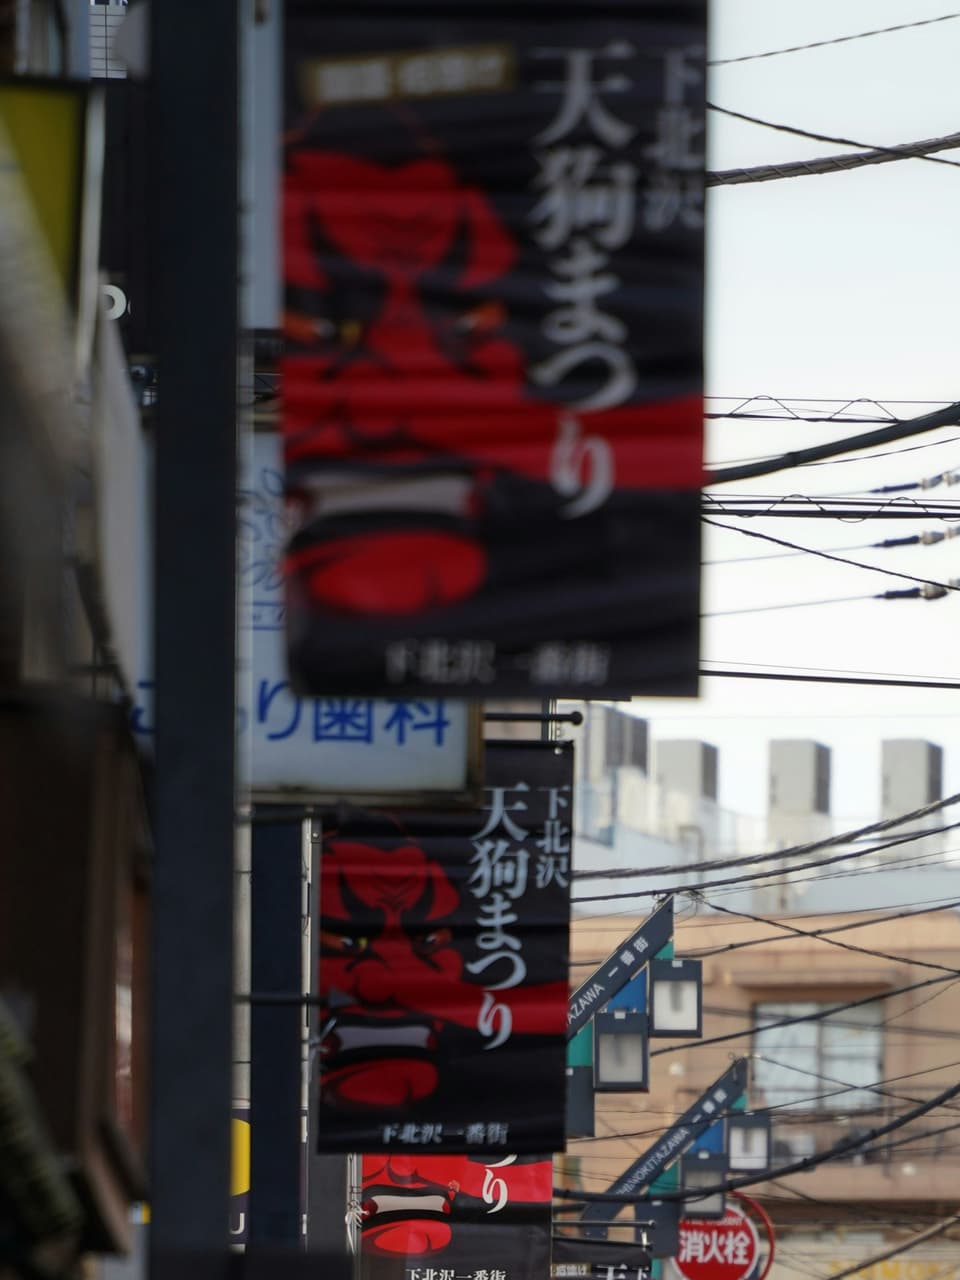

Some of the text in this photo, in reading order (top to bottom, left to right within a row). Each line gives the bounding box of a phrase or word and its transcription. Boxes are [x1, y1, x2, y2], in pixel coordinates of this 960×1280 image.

[527, 40, 638, 518] 天狗まつり
[535, 784, 570, 888] 下北沢
[466, 782, 530, 1050] 天狗まつり
[382, 1122, 508, 1145] 下北沢一番街
[678, 1229, 750, 1265] 消火栓
